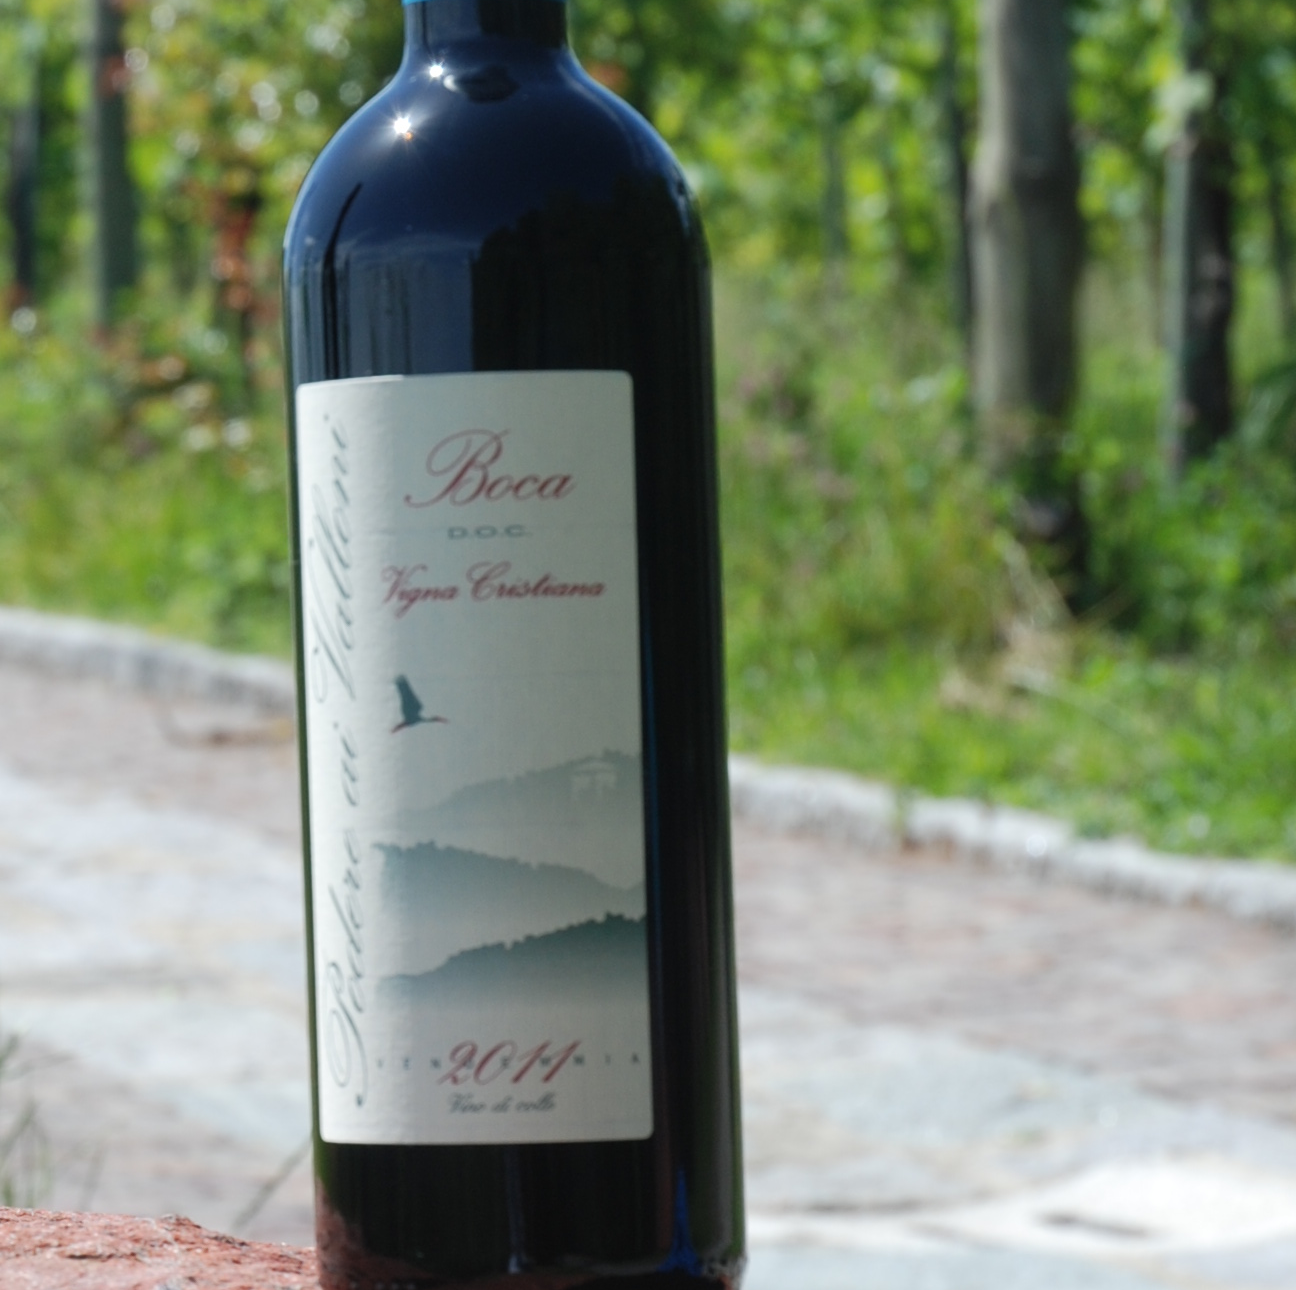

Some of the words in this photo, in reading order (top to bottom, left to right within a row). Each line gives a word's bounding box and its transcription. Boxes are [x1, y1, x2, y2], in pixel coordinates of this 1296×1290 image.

[404, 428, 577, 509] Boca
[308, 412, 356, 705] Valloni
[448, 523, 531, 541] D.O.C.
[381, 564, 459, 621] Vigna
[465, 561, 607, 604] Cristiana
[331, 721, 362, 808] ai
[323, 829, 369, 1107] Podere
[437, 1039, 583, 1086] 2011
